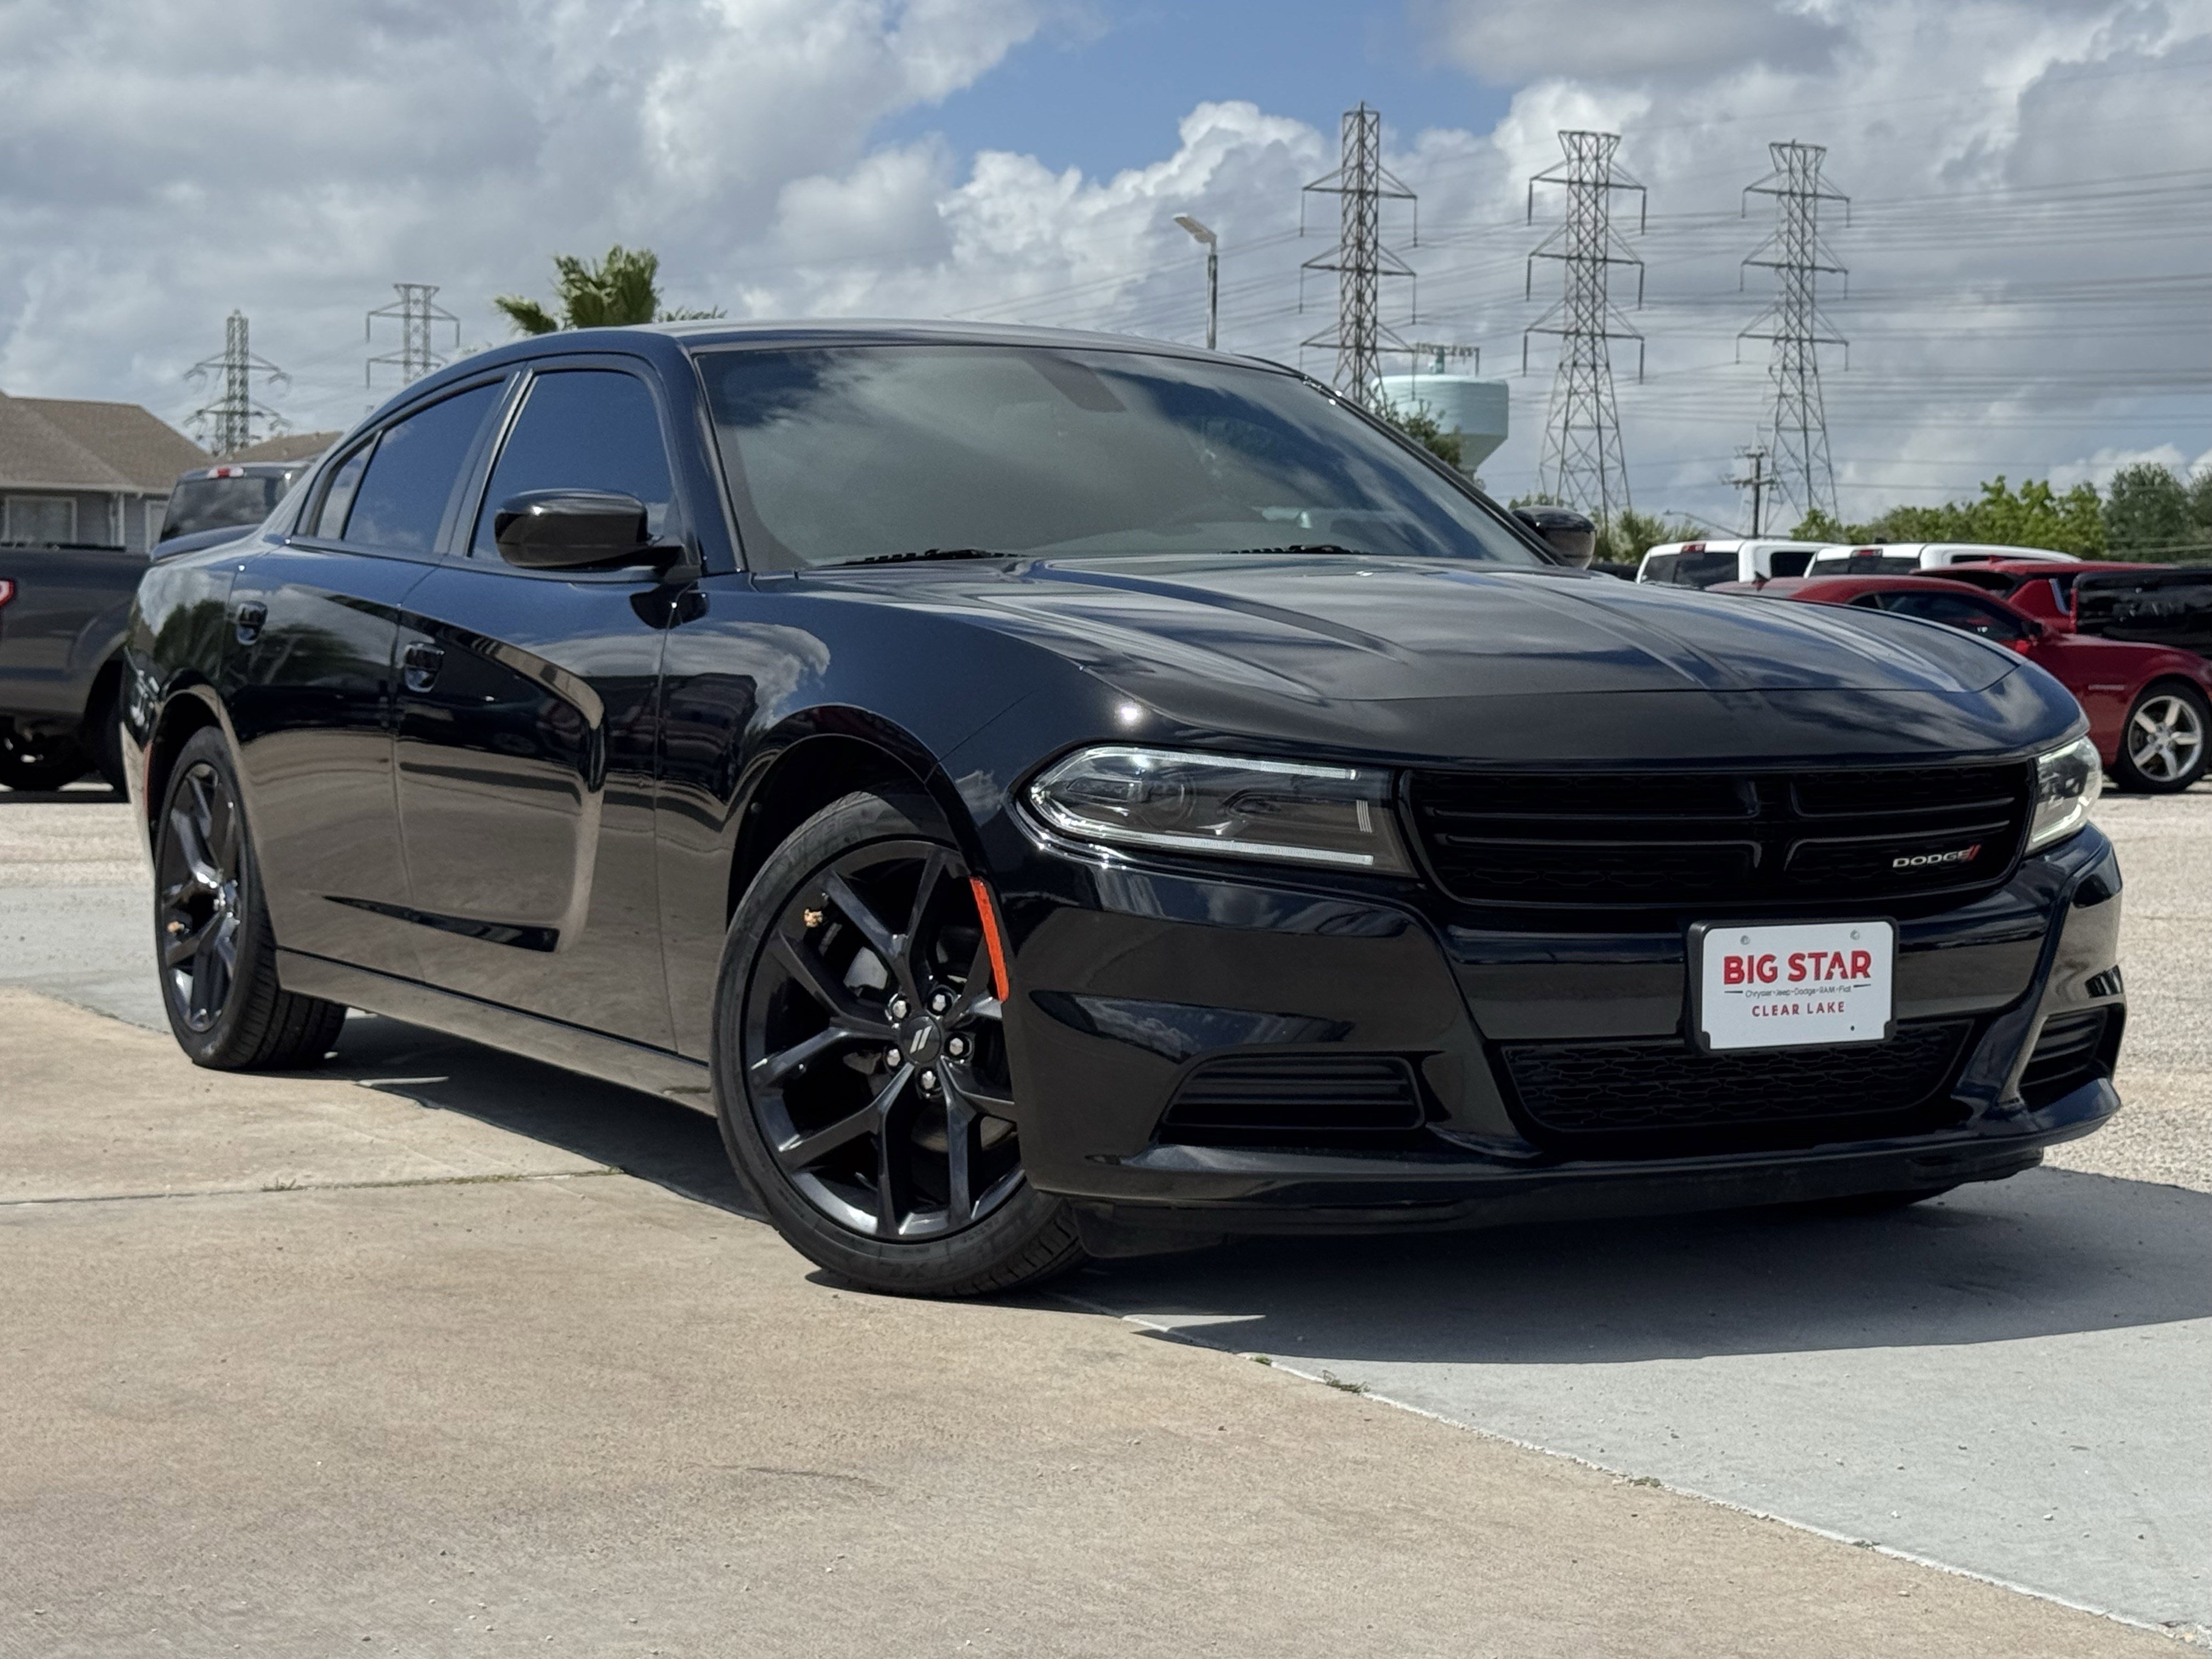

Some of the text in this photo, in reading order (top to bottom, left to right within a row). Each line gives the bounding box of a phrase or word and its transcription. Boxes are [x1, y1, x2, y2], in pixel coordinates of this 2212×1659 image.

[1893, 849, 1973, 868] DODGE
[1724, 950, 1871, 985] BIG STAR
[1752, 1001, 1845, 1017] CLEAR LAKE
